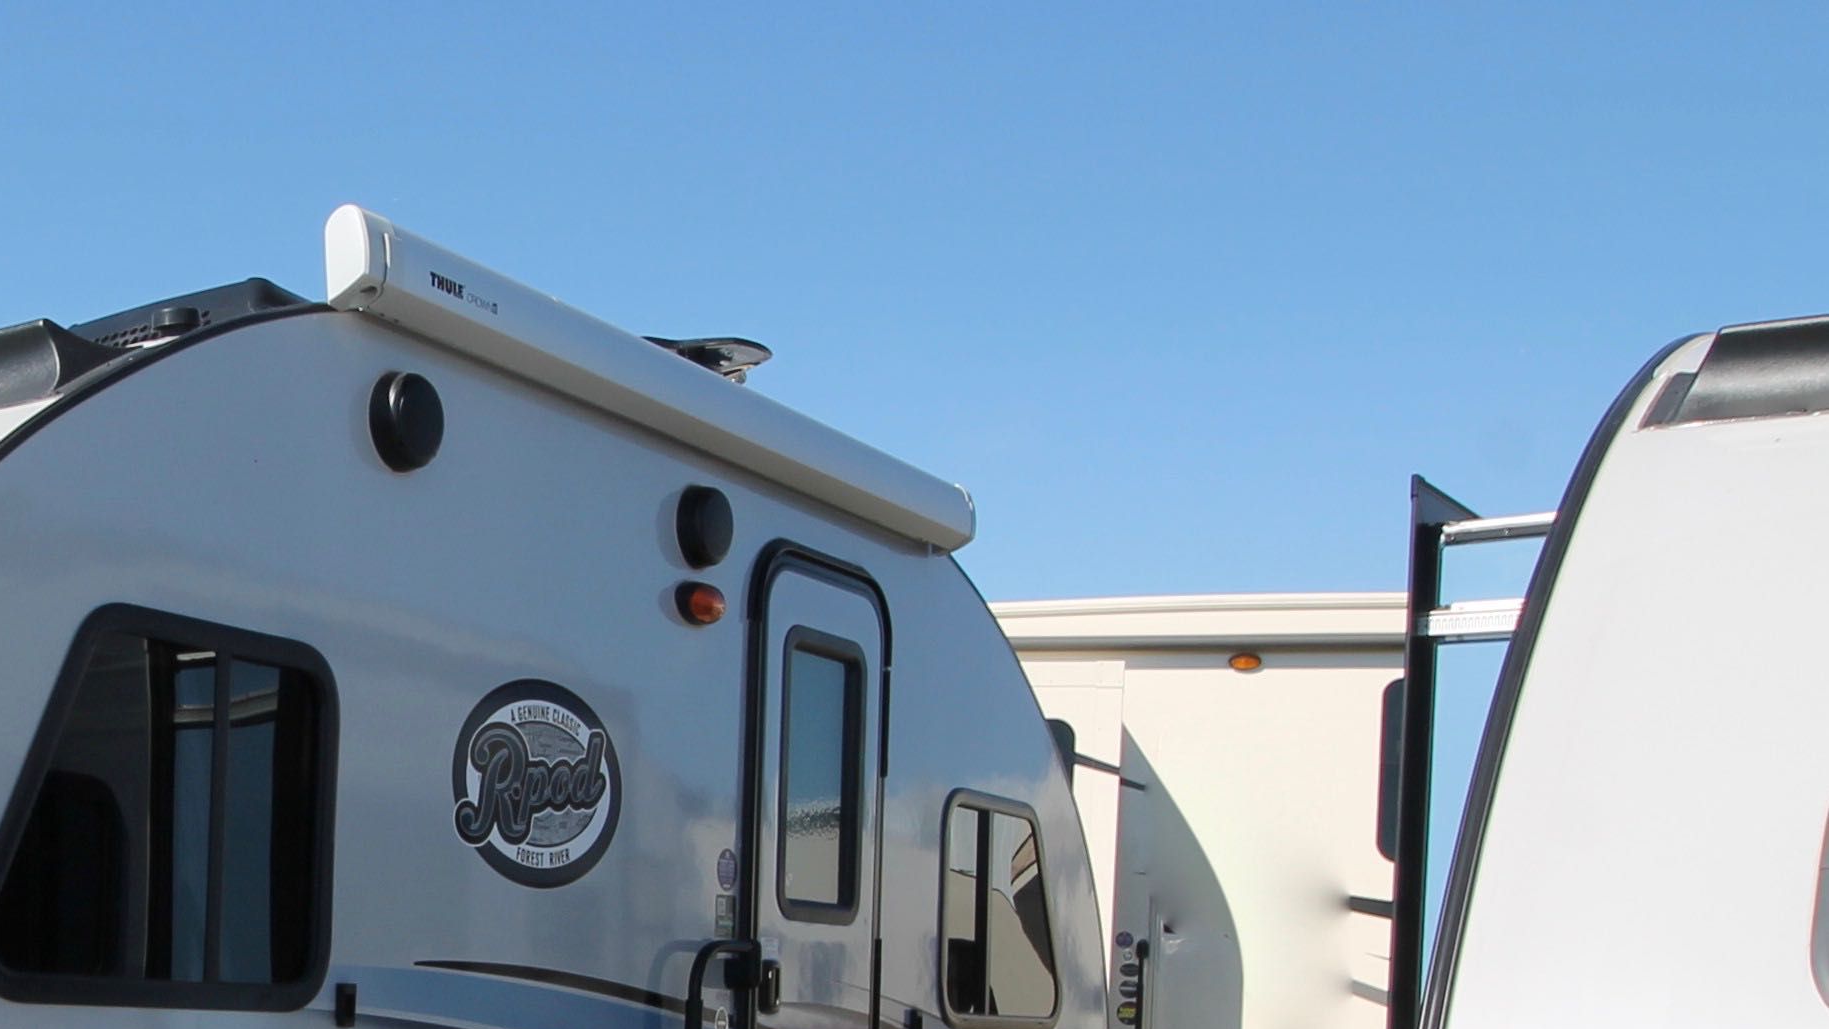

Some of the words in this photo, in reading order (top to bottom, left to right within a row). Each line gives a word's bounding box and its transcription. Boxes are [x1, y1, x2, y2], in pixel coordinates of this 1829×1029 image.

[430, 271, 464, 300] THULE
[510, 708, 516, 722] A
[517, 705, 550, 721] GENUINE
[516, 846, 544, 866] FOREST
[549, 848, 570, 866] RIVER
